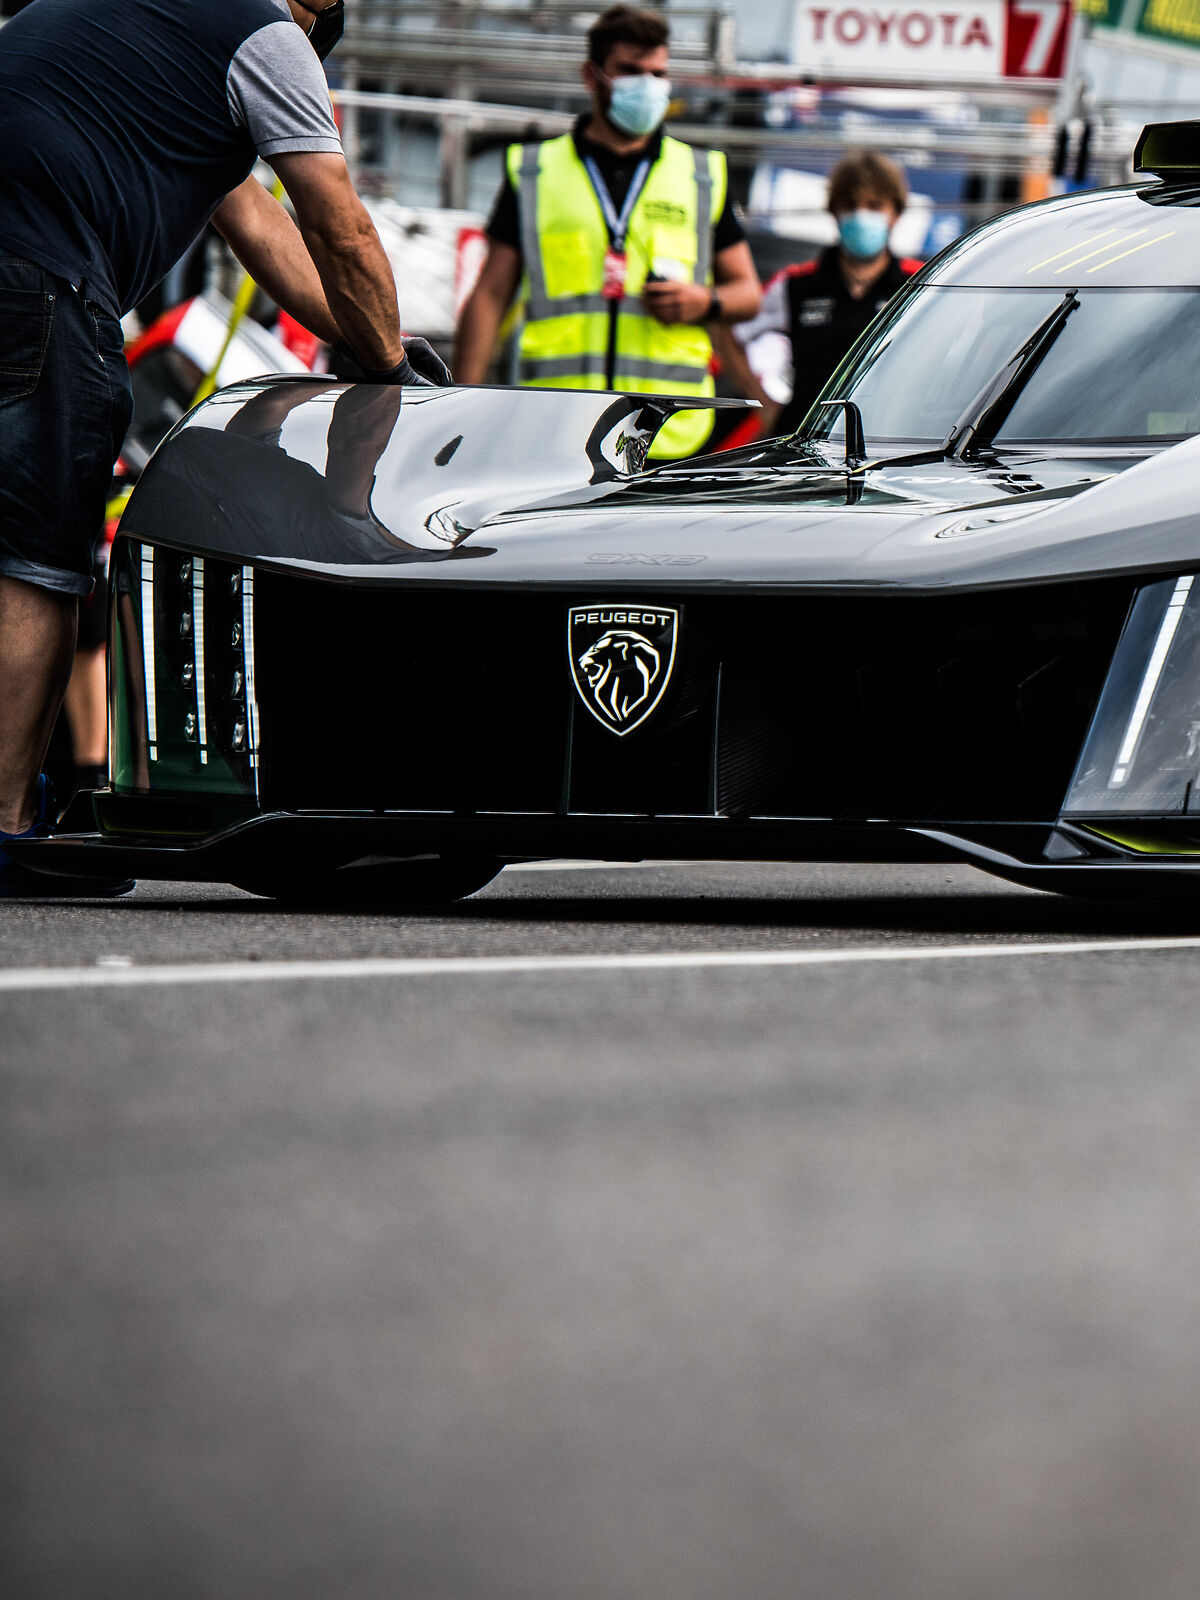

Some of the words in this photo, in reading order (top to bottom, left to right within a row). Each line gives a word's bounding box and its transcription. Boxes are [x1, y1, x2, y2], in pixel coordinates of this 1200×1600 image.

[807, 9, 992, 48] TOYOTA
[1012, 2, 1066, 74] 7
[584, 553, 707, 566] 9X8
[574, 612, 671, 626] PEUGEOT
